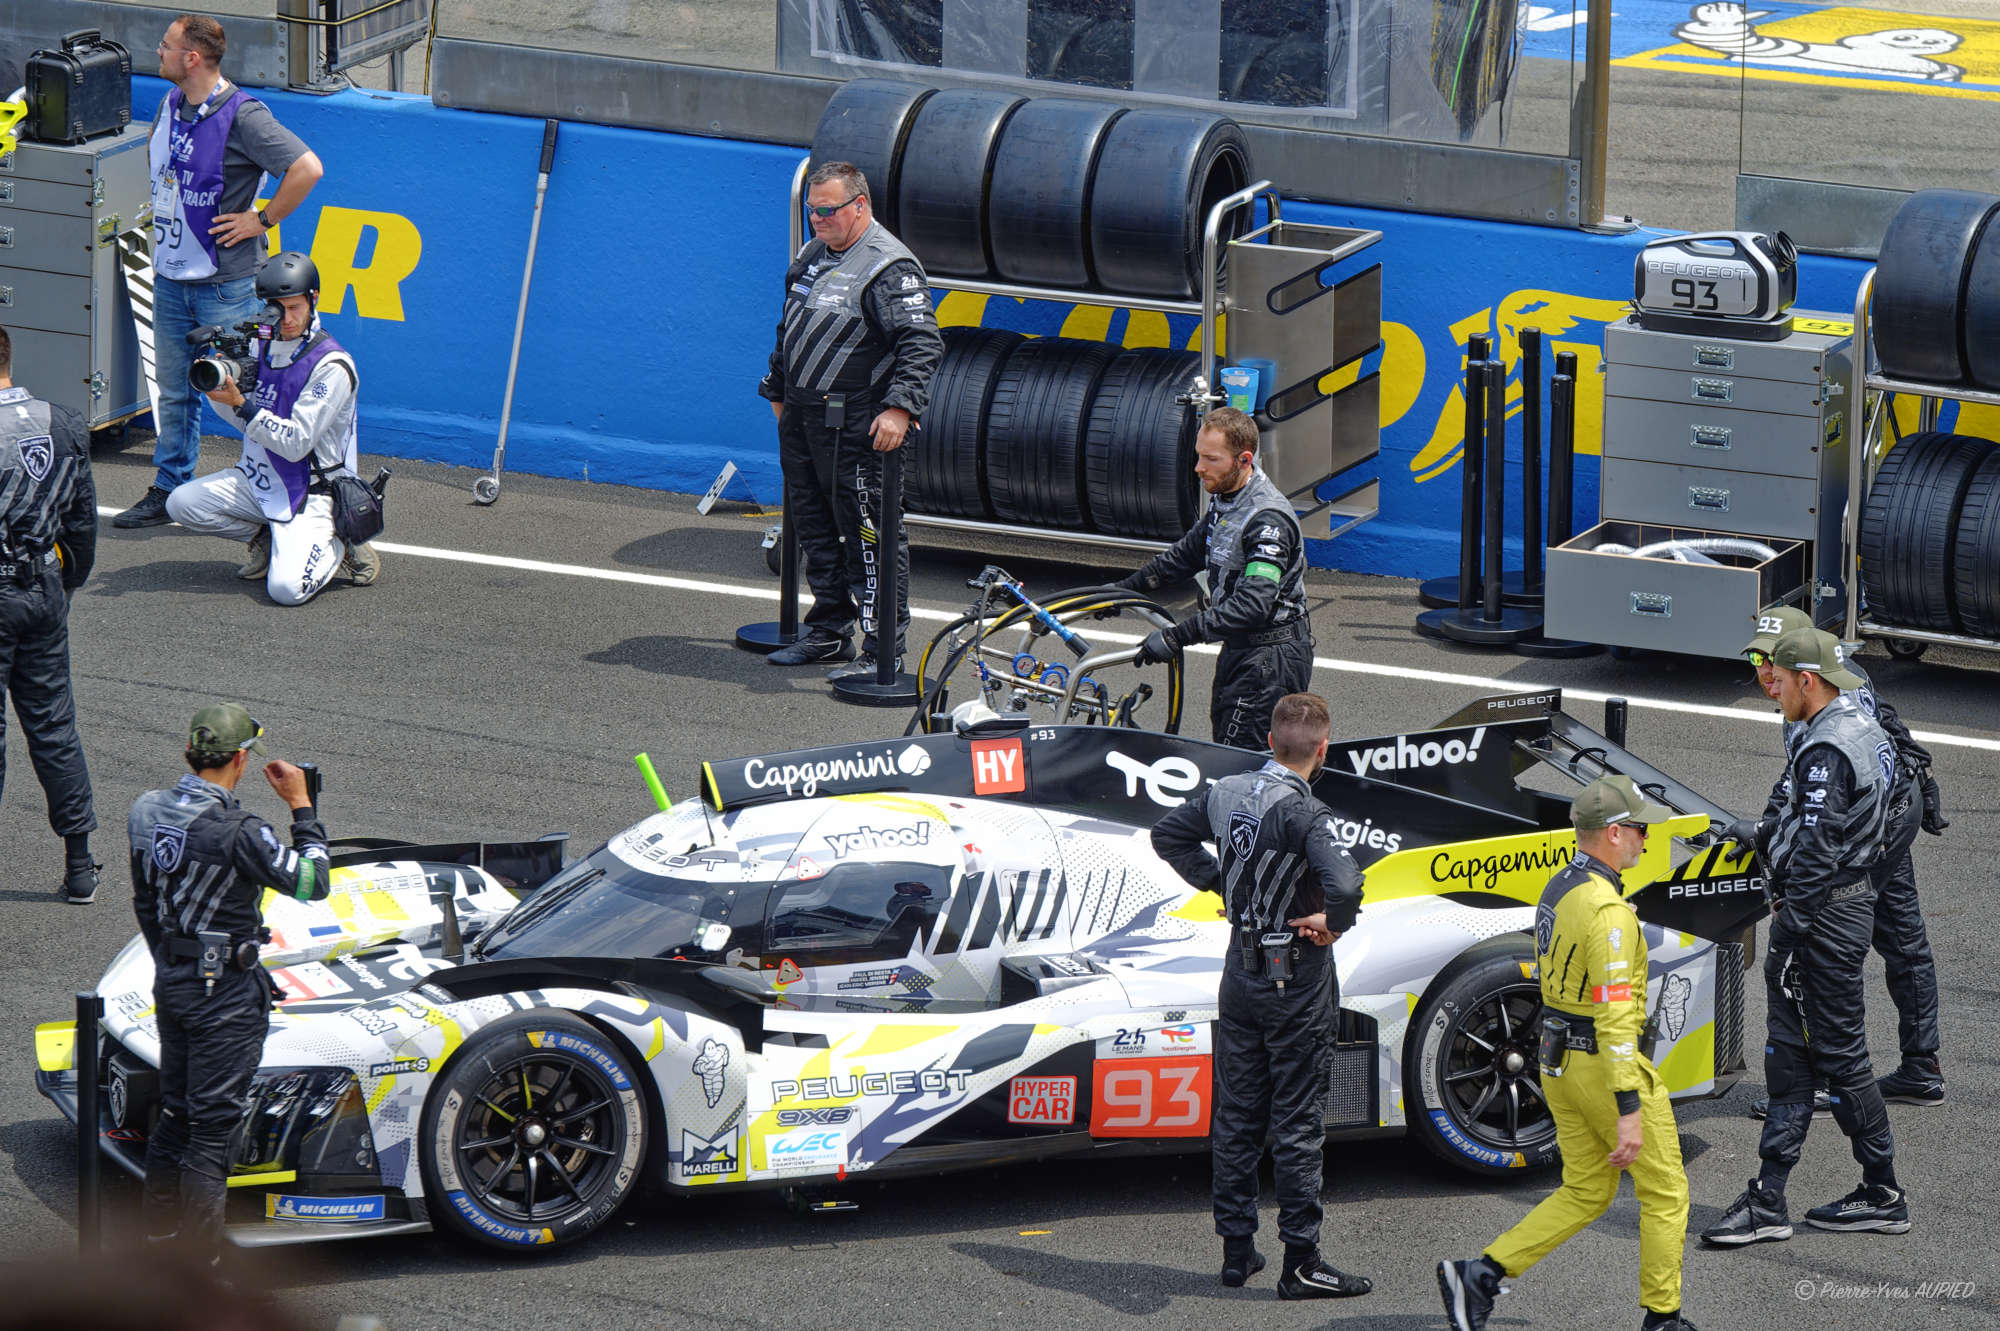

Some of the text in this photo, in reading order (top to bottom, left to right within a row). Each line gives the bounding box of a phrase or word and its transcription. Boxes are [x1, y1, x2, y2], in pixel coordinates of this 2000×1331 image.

[183, 189, 217, 206] TRACK
[1647, 261, 1749, 280] PEUGEOT
[1672, 279, 1718, 311] 93
[1805, 321, 1851, 333] 93
[246, 456, 271, 490] 56
[856, 464, 878, 632] PEUGEOT SPORT
[1757, 616, 1783, 634] 93
[1488, 694, 1556, 710] PEUGEOT
[1031, 730, 1056, 741] #93
[1347, 726, 1487, 777] yahoo!
[744, 749, 899, 797] Capgemini
[976, 748, 1018, 784] HY
[824, 821, 930, 859] yahoo!
[1430, 838, 1578, 888] Capgemini
[1669, 877, 1764, 899] PEUGEO
[558, 1035, 626, 1085] MICHELIN
[772, 1068, 973, 1105] PEUGEOT
[1014, 1081, 1071, 1097] HYPER
[1103, 1066, 1200, 1127] 93
[777, 1106, 853, 1127] 9X8
[1013, 1097, 1069, 1120] CAR
[772, 1132, 841, 1155] WEC
[1434, 1115, 1500, 1164] MICHELIN
[683, 1161, 737, 1175] MARELLI
[298, 1203, 375, 1215] MICHELIN
[454, 1196, 526, 1242] MICHELIN
